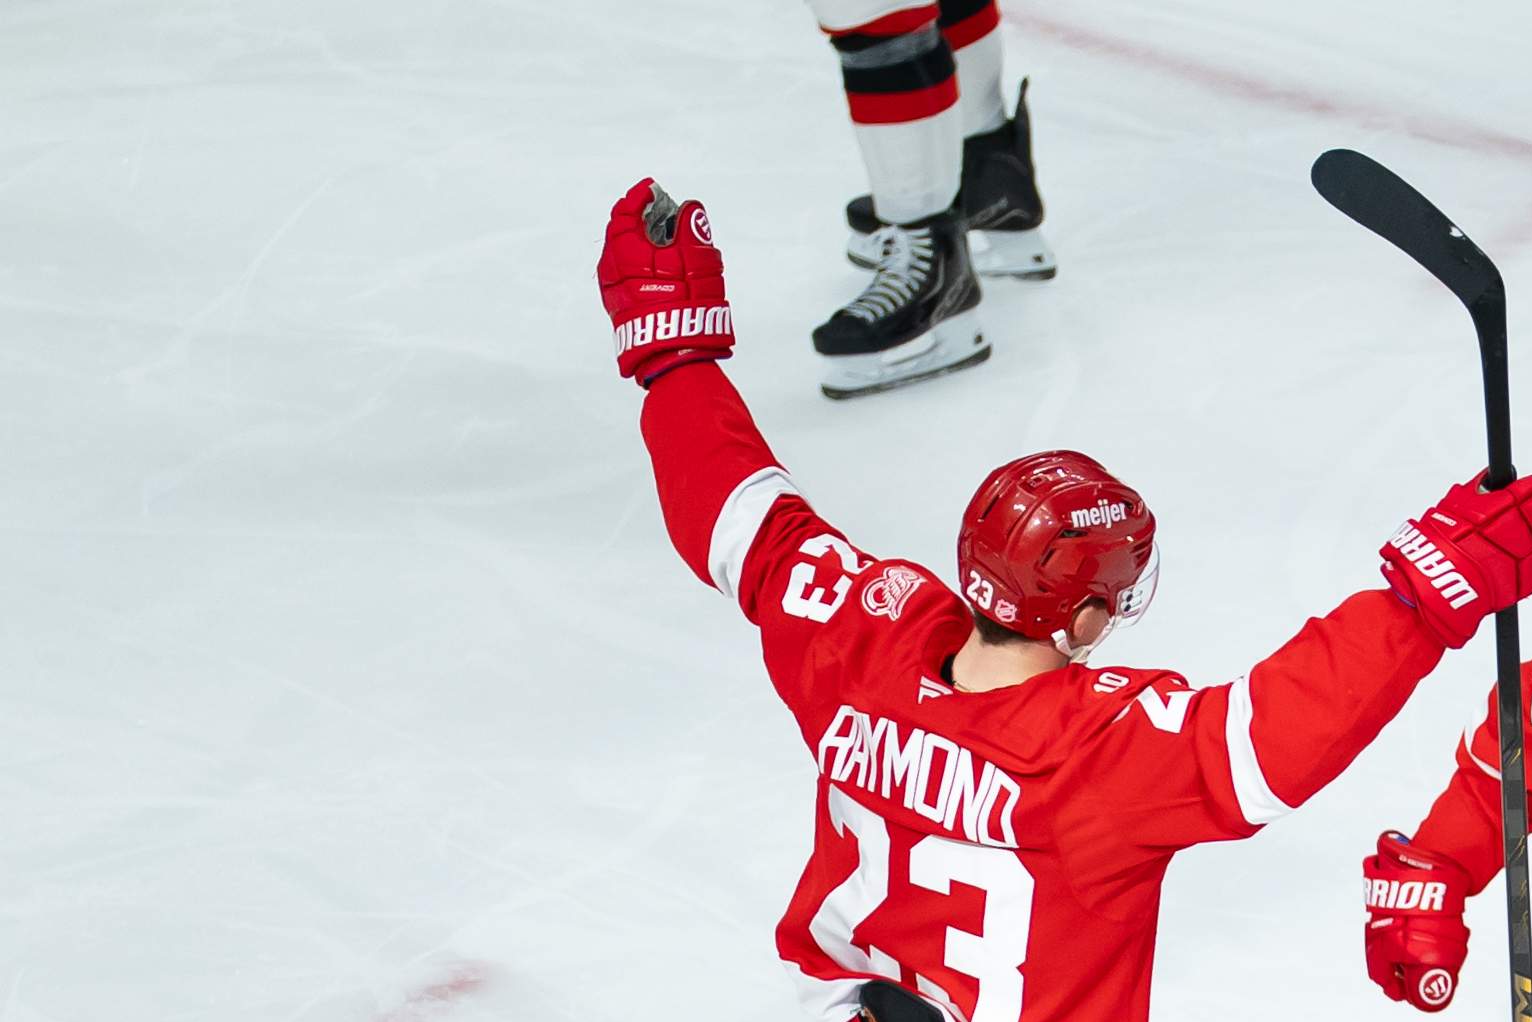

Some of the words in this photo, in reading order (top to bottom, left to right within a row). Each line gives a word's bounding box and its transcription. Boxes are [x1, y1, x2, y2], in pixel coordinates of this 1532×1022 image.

[1071, 499, 1127, 529] meijer
[782, 533, 874, 624] 23
[966, 570, 994, 610] 23
[818, 704, 1021, 849] RAYMOND
